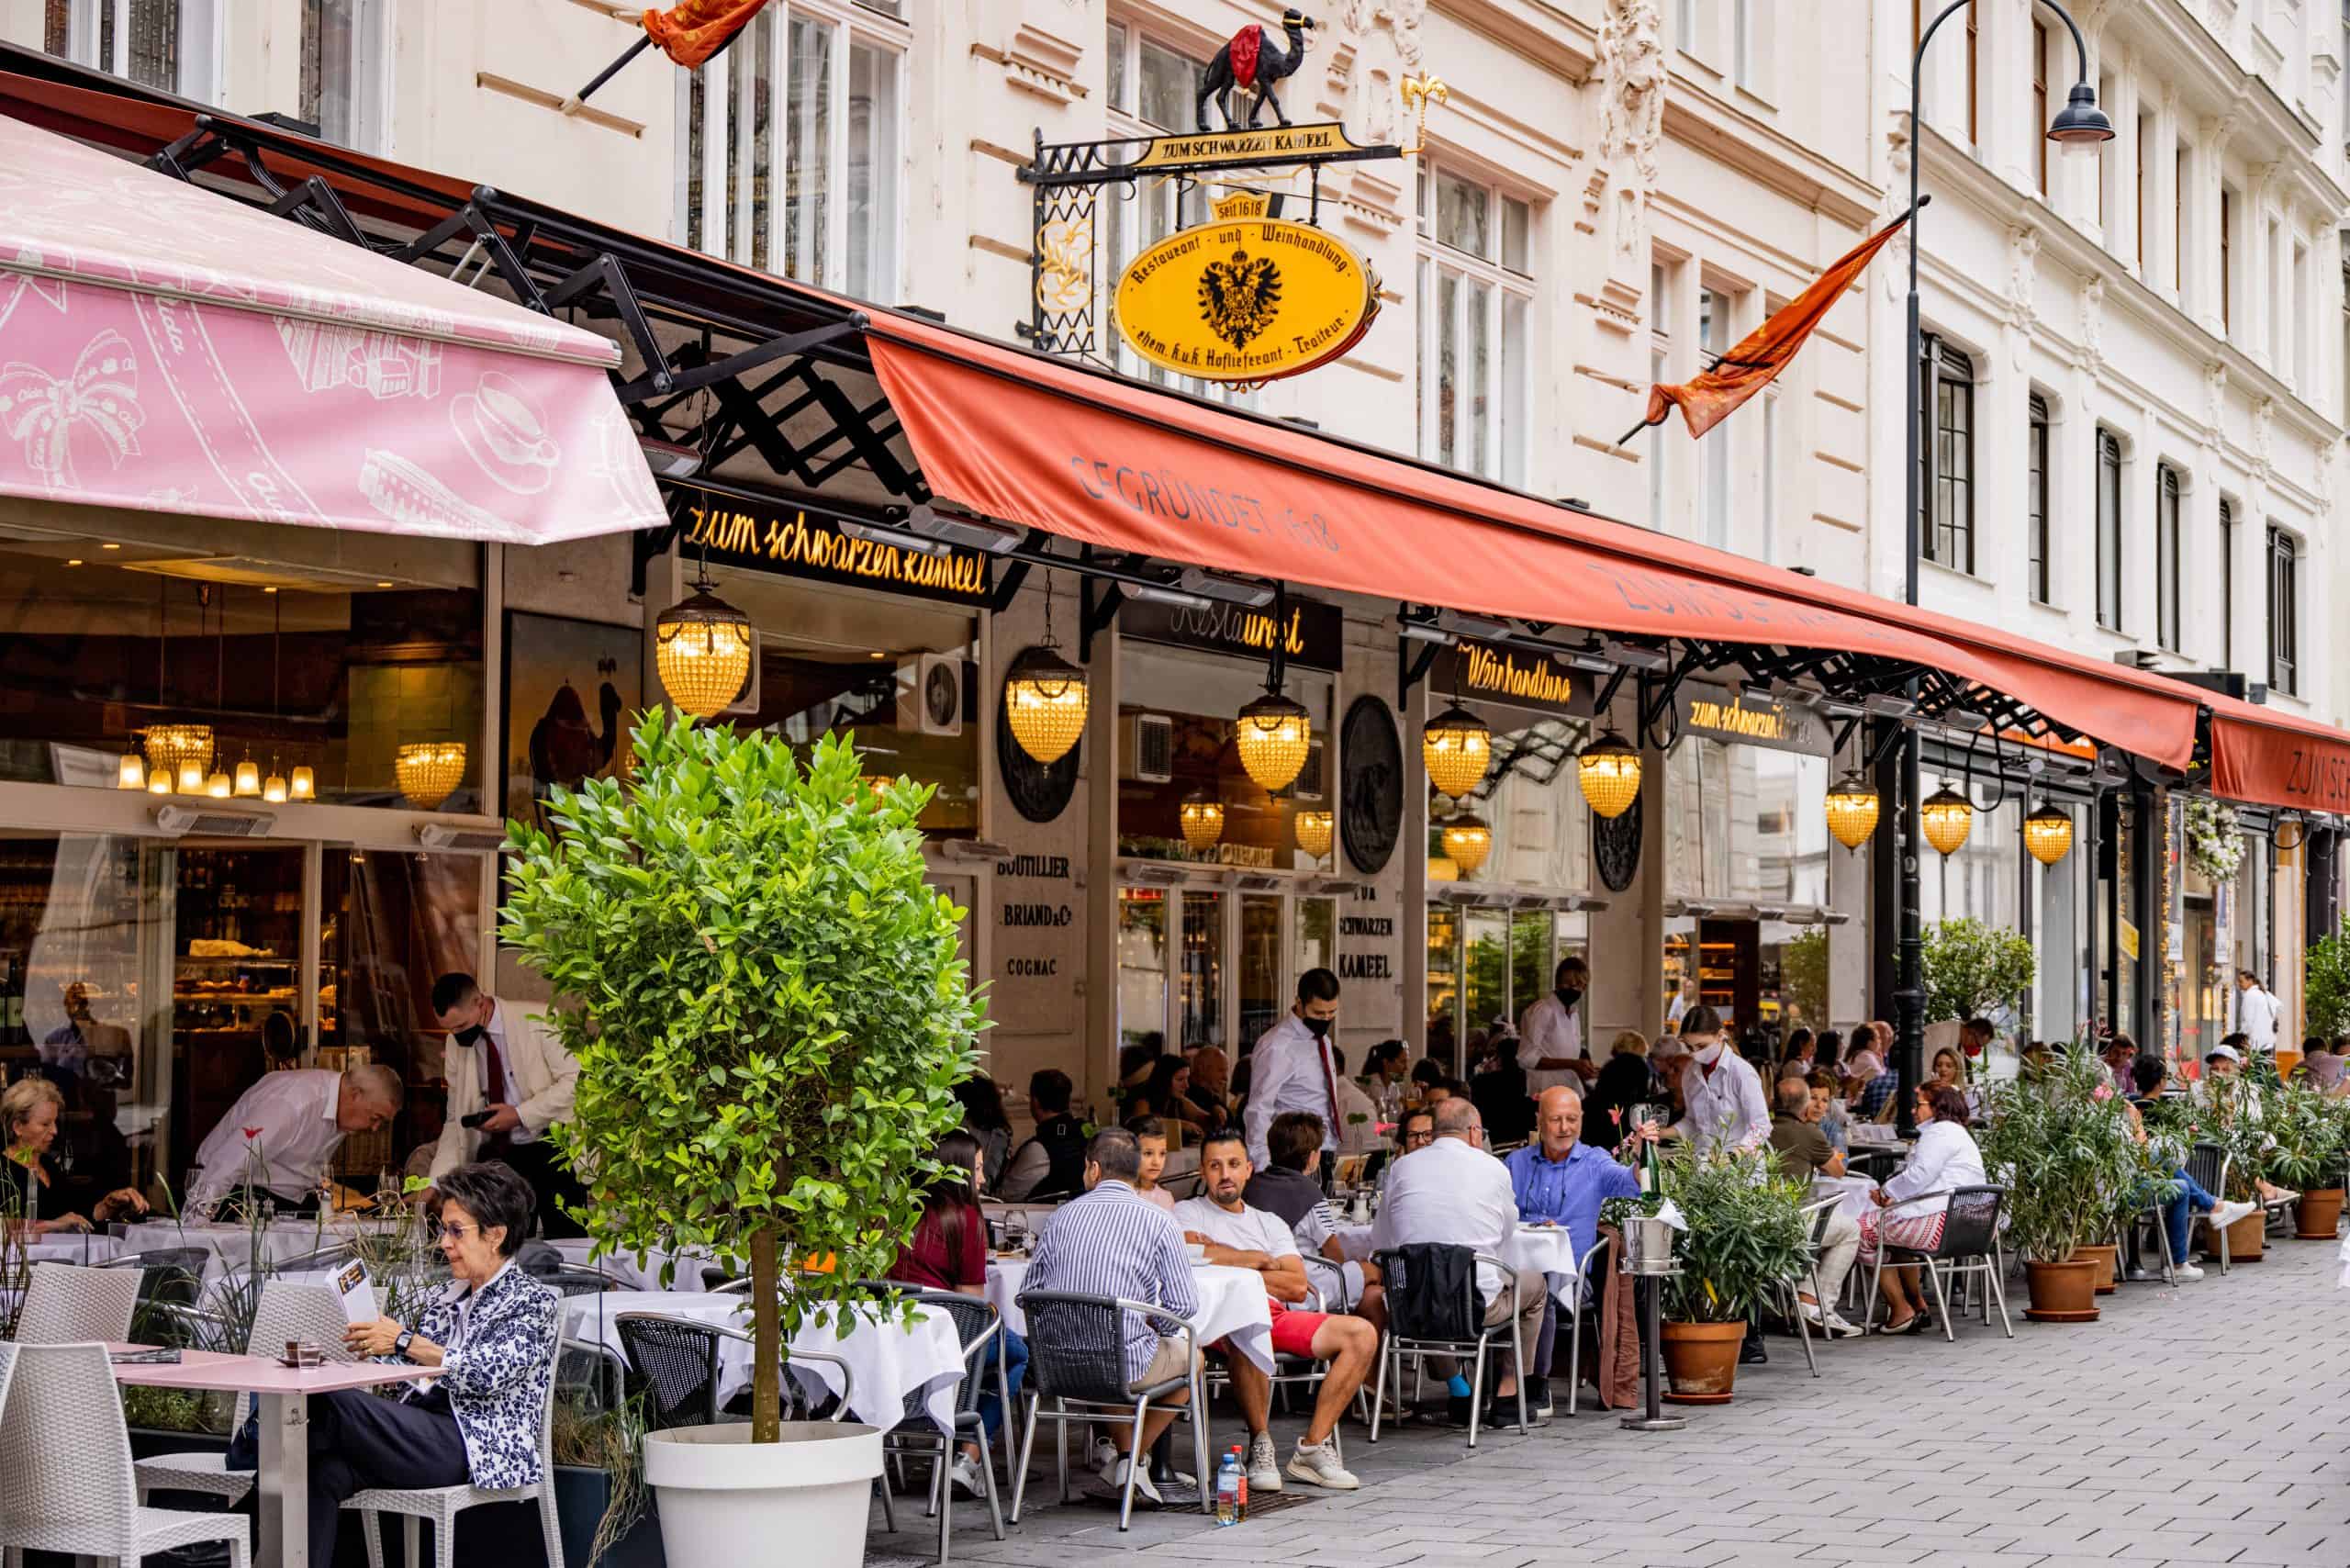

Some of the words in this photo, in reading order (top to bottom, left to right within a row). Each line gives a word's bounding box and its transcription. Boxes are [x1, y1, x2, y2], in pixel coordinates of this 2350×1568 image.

[1162, 141, 1191, 159] ZUM
[1192, 136, 1272, 156] SCHWARZEN
[1275, 131, 1332, 150] KAMEEL
[1218, 201, 1237, 218] seit
[1238, 201, 1262, 217] 1618
[1131, 236, 1201, 285] Restaurant
[1219, 229, 1242, 244] und
[1262, 222, 1348, 274] Weinhandlung
[1206, 349, 1283, 370] Hoflieferant
[1292, 318, 1346, 354] Traiteur
[765, 510, 902, 580] schwarzen
[2286, 749, 2326, 796] ZUM
[1007, 958, 1058, 975] COGNAC
[1338, 954, 1393, 979] KAMEEL
